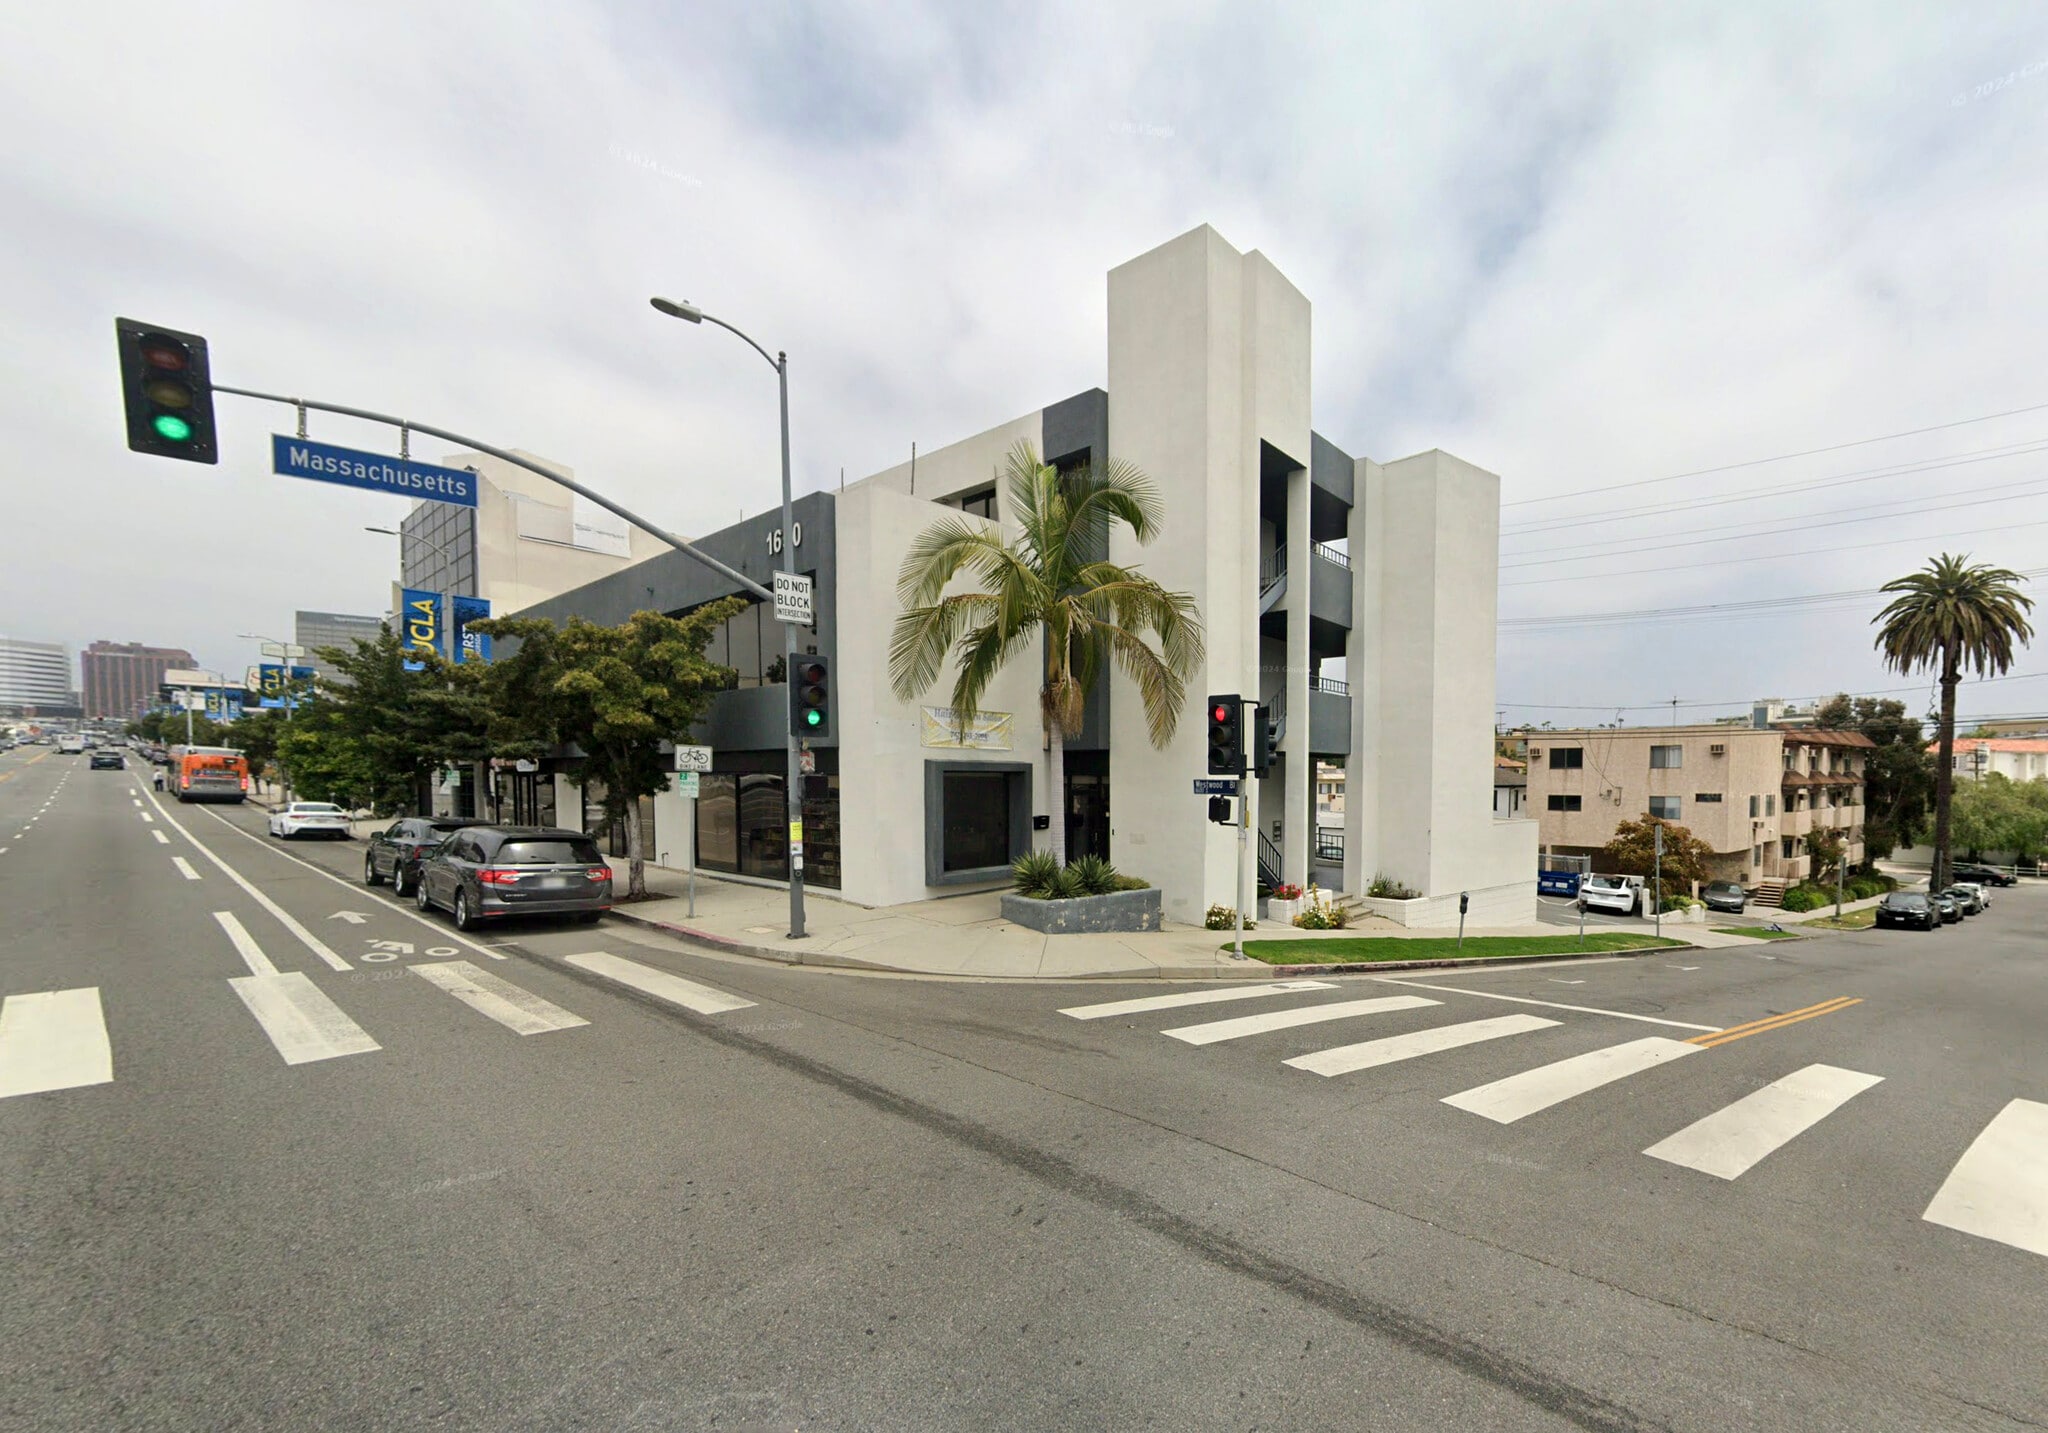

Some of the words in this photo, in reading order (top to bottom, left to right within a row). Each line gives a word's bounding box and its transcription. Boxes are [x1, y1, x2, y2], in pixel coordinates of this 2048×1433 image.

[289, 446, 467, 496] Massachusetts
[766, 522, 801, 555] 160
[776, 578, 789, 590] DO
[791, 581, 809, 593] NOT
[777, 594, 810, 608] BLOCK
[777, 607, 811, 619] INTERSECTION
[265, 669, 280, 695] CLA
